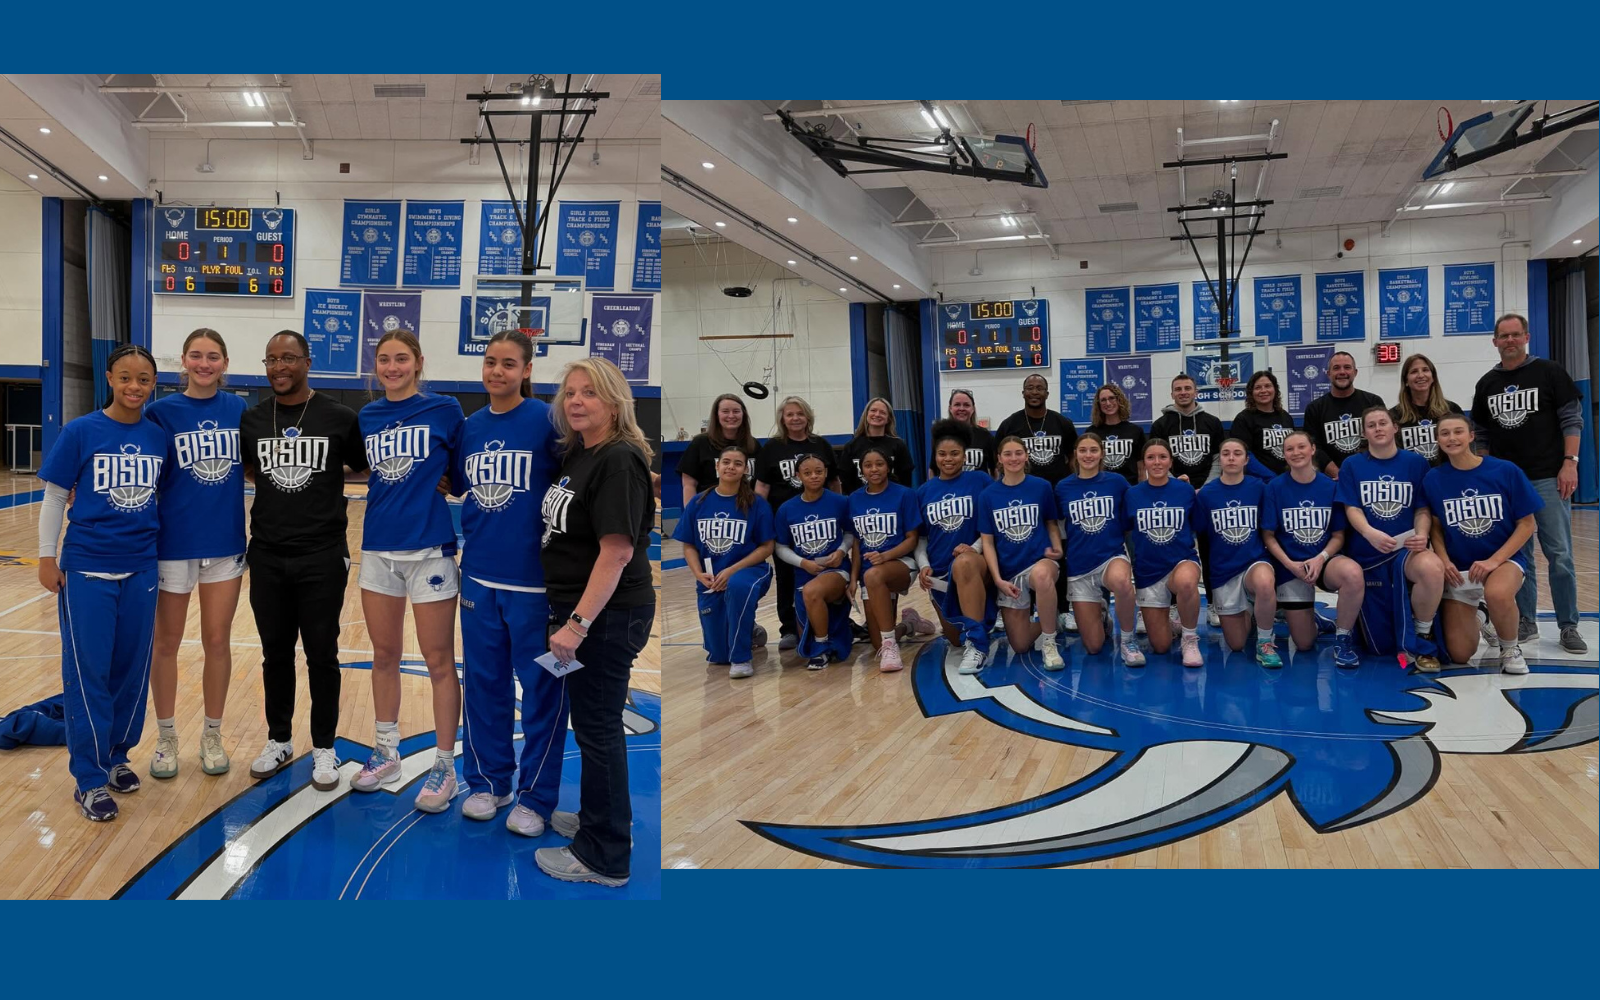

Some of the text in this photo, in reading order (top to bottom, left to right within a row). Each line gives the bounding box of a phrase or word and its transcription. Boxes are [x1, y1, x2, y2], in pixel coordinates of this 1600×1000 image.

[204, 210, 249, 227] 15:00
[166, 231, 188, 240] HOME
[256, 232, 283, 241] GUEST
[178, 242, 190, 260] 0
[223, 245, 228, 258] 1
[273, 244, 284, 262] 0
[161, 264, 176, 274] FLS
[202, 265, 244, 275] PLYR FOUL
[269, 266, 284, 276] FLS
[166, 276, 175, 291] 0
[186, 277, 195, 291] 6
[249, 278, 258, 293] 6
[977, 302, 1012, 318] 15:00
[1018, 318, 1040, 326] GUEST
[958, 330, 967, 344] 0
[1032, 326, 1041, 341] 0
[464, 344, 487, 352] HIG
[1380, 345, 1398, 361] 30
[965, 356, 973, 368] 6
[1015, 354, 1023, 366] 6
[1488, 389, 1539, 419] BISON
[174, 430, 242, 469] BISON
[365, 427, 430, 472] BISON
[1169, 434, 1211, 456] BISON
[257, 439, 329, 473] BISON
[93, 456, 163, 492] BISON
[268, 476, 314, 493] BASKETBALL
[1360, 483, 1413, 507] BISON
[106, 496, 154, 513] BASKETBALL
[470, 495, 516, 513] BASKETBALL
[927, 496, 974, 525] BISON
[1069, 497, 1114, 524] BISON
[1443, 496, 1504, 526] BISON
[853, 513, 897, 539] BISON
[993, 505, 1039, 533] BISON
[1137, 508, 1185, 532] BISON
[1211, 507, 1258, 533] BISON
[1282, 508, 1332, 532] BISON
[698, 519, 748, 544] BISON
[789, 519, 837, 548] BISON
